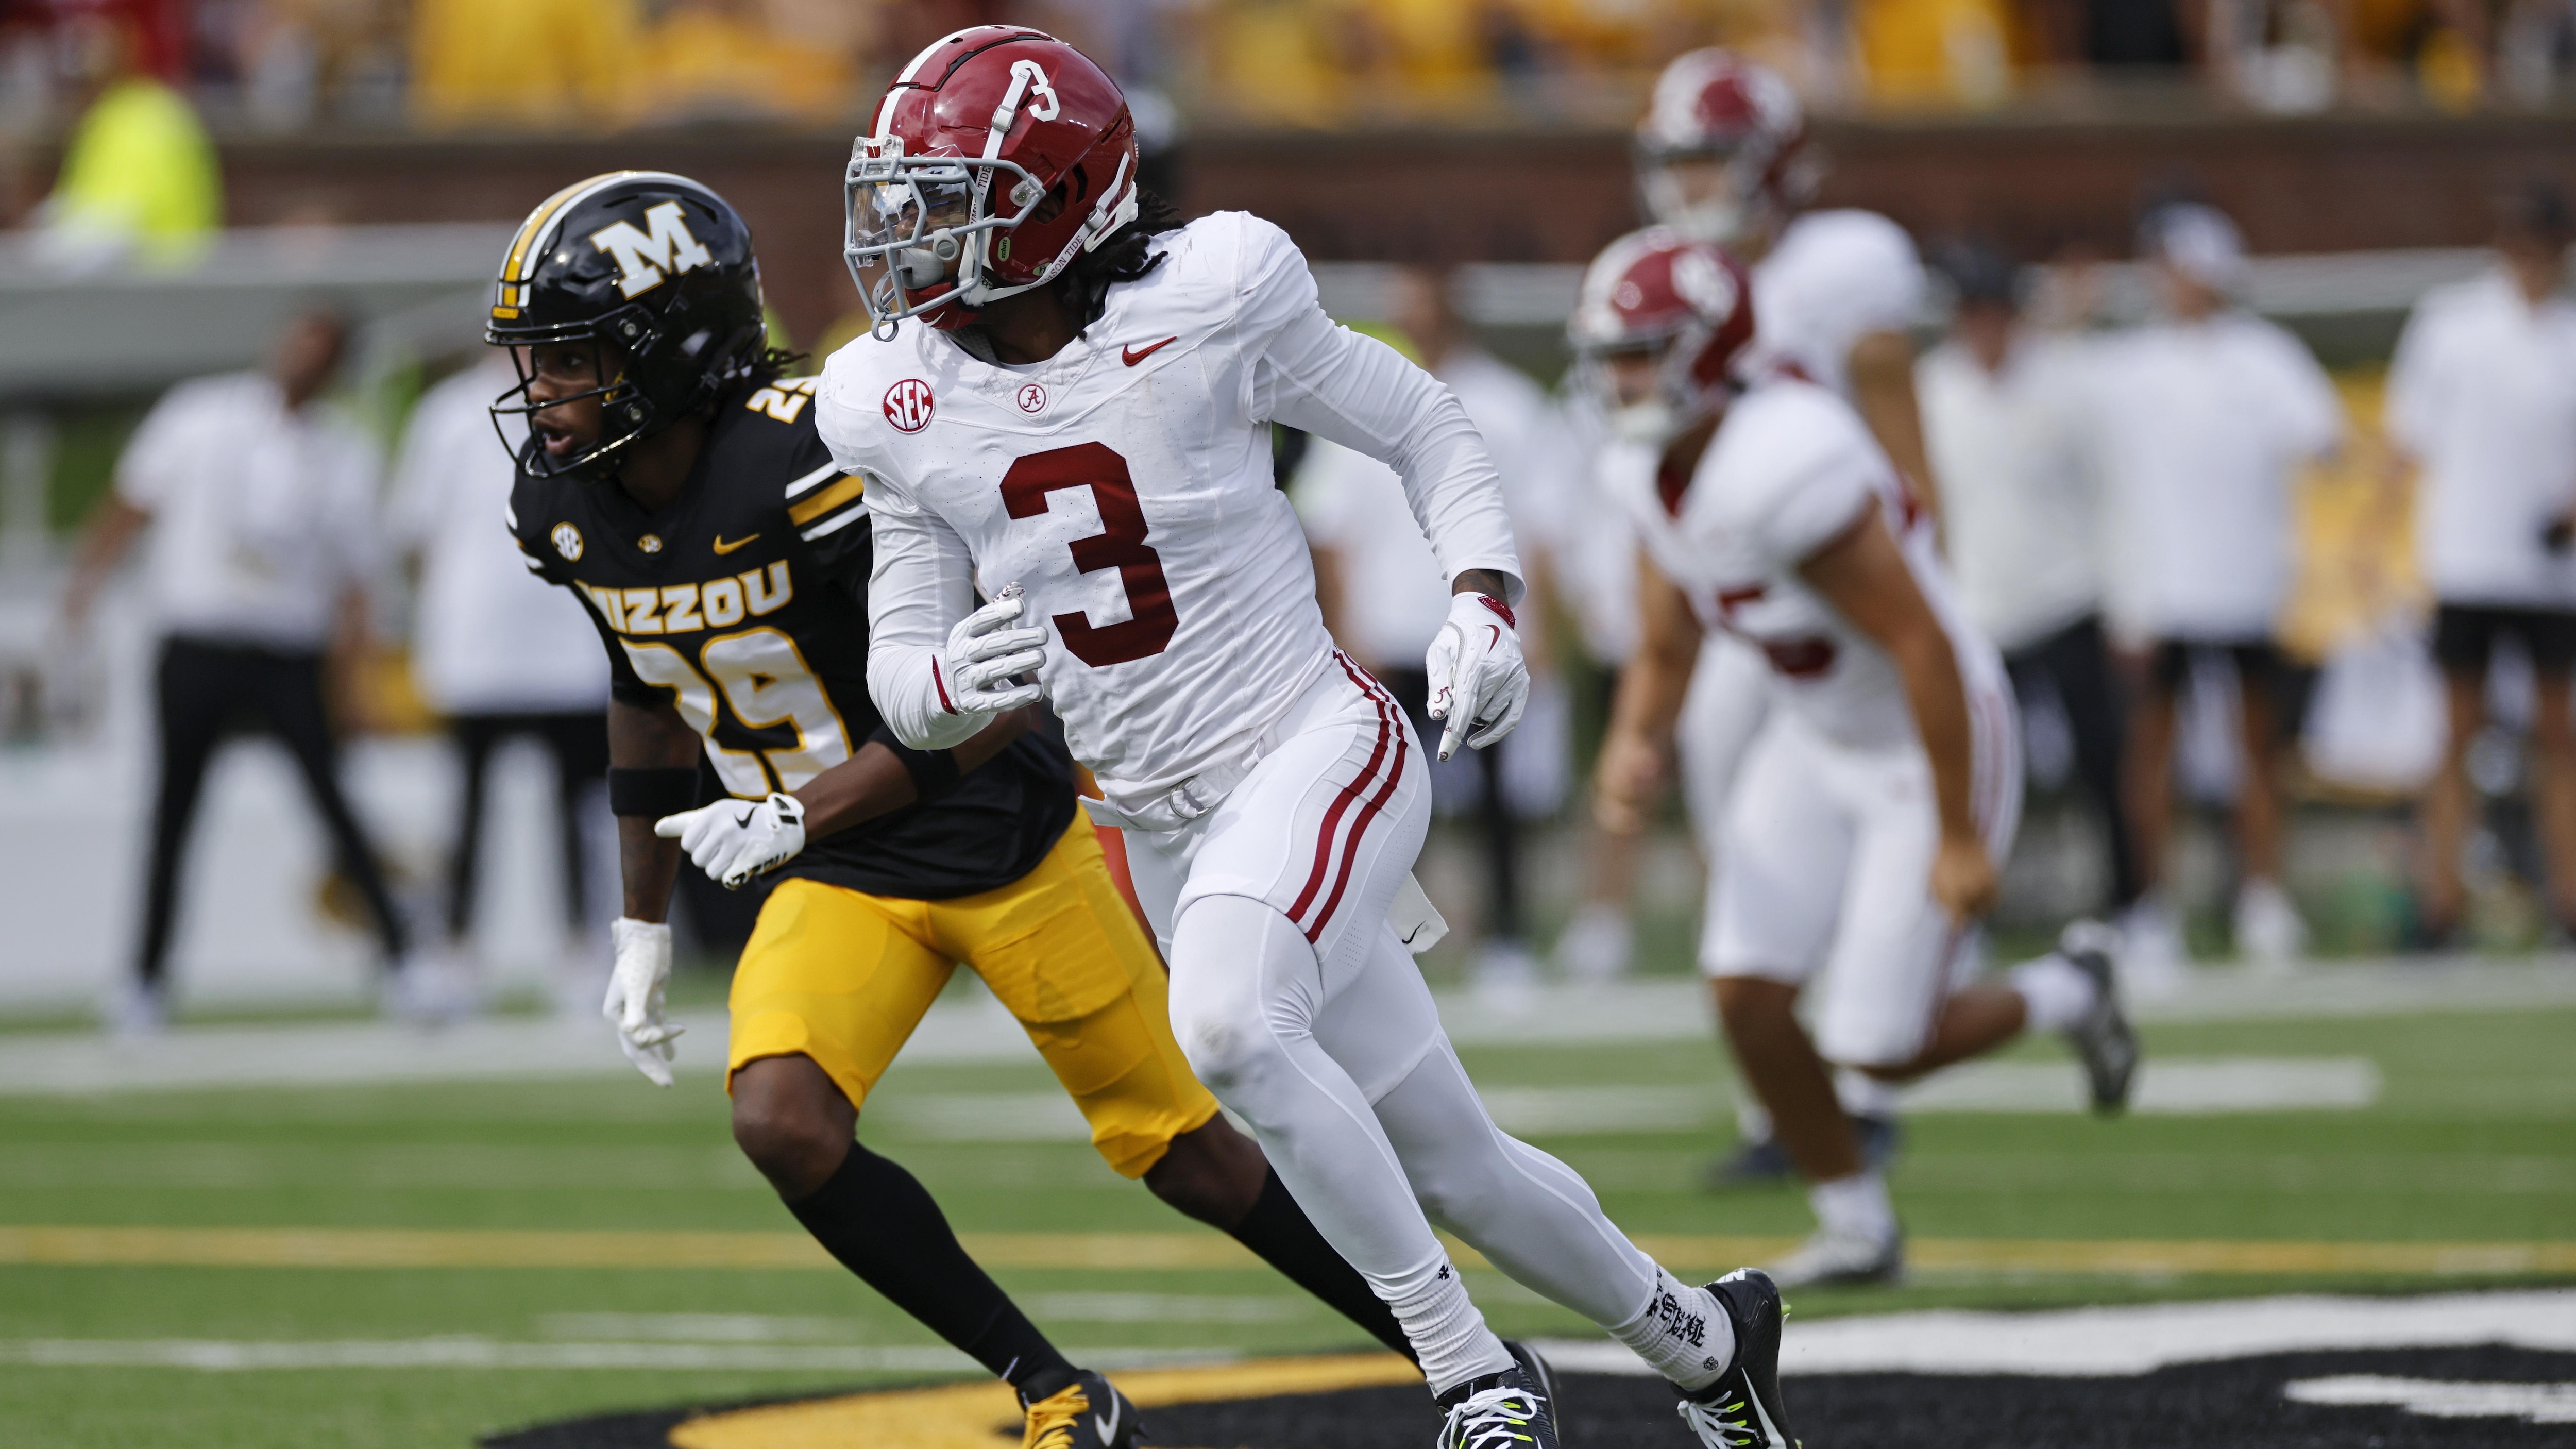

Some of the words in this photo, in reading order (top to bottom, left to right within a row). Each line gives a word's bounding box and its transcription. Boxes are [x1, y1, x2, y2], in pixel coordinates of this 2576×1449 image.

[1010, 59, 1060, 122] 3
[589, 200, 713, 301] M
[1027, 257, 1066, 289] MSON
[1065, 235, 1083, 257] TIDE
[885, 381, 931, 429] SEC
[999, 441, 1179, 668] 3
[618, 625, 854, 800] 29
